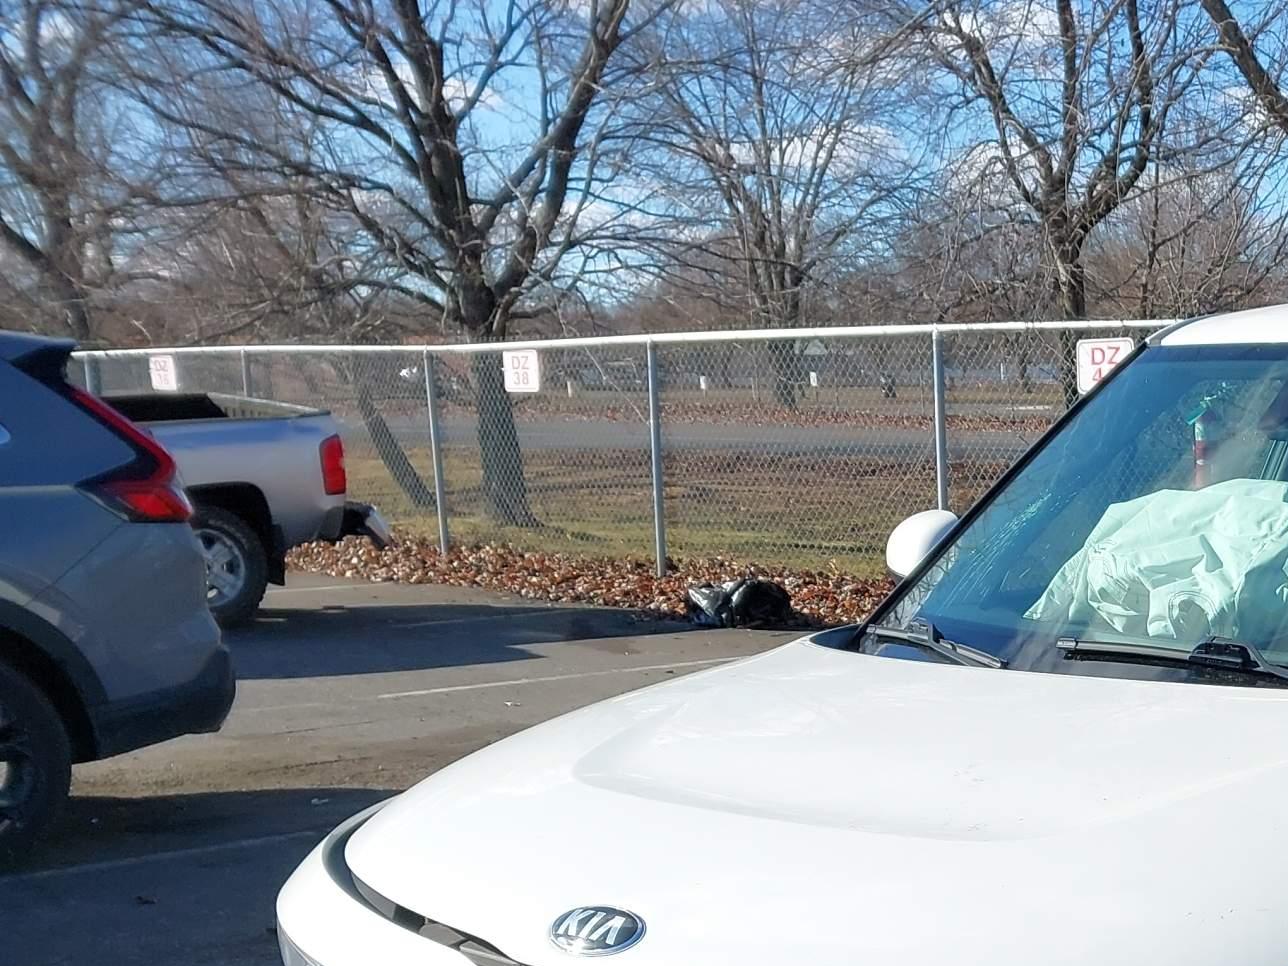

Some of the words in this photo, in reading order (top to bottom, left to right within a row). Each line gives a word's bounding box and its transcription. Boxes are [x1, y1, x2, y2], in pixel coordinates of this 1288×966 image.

[511, 355, 529, 370] DZ
[1090, 346, 1121, 366] DZ
[512, 371, 529, 385] 38
[555, 908, 627, 946] KIA
